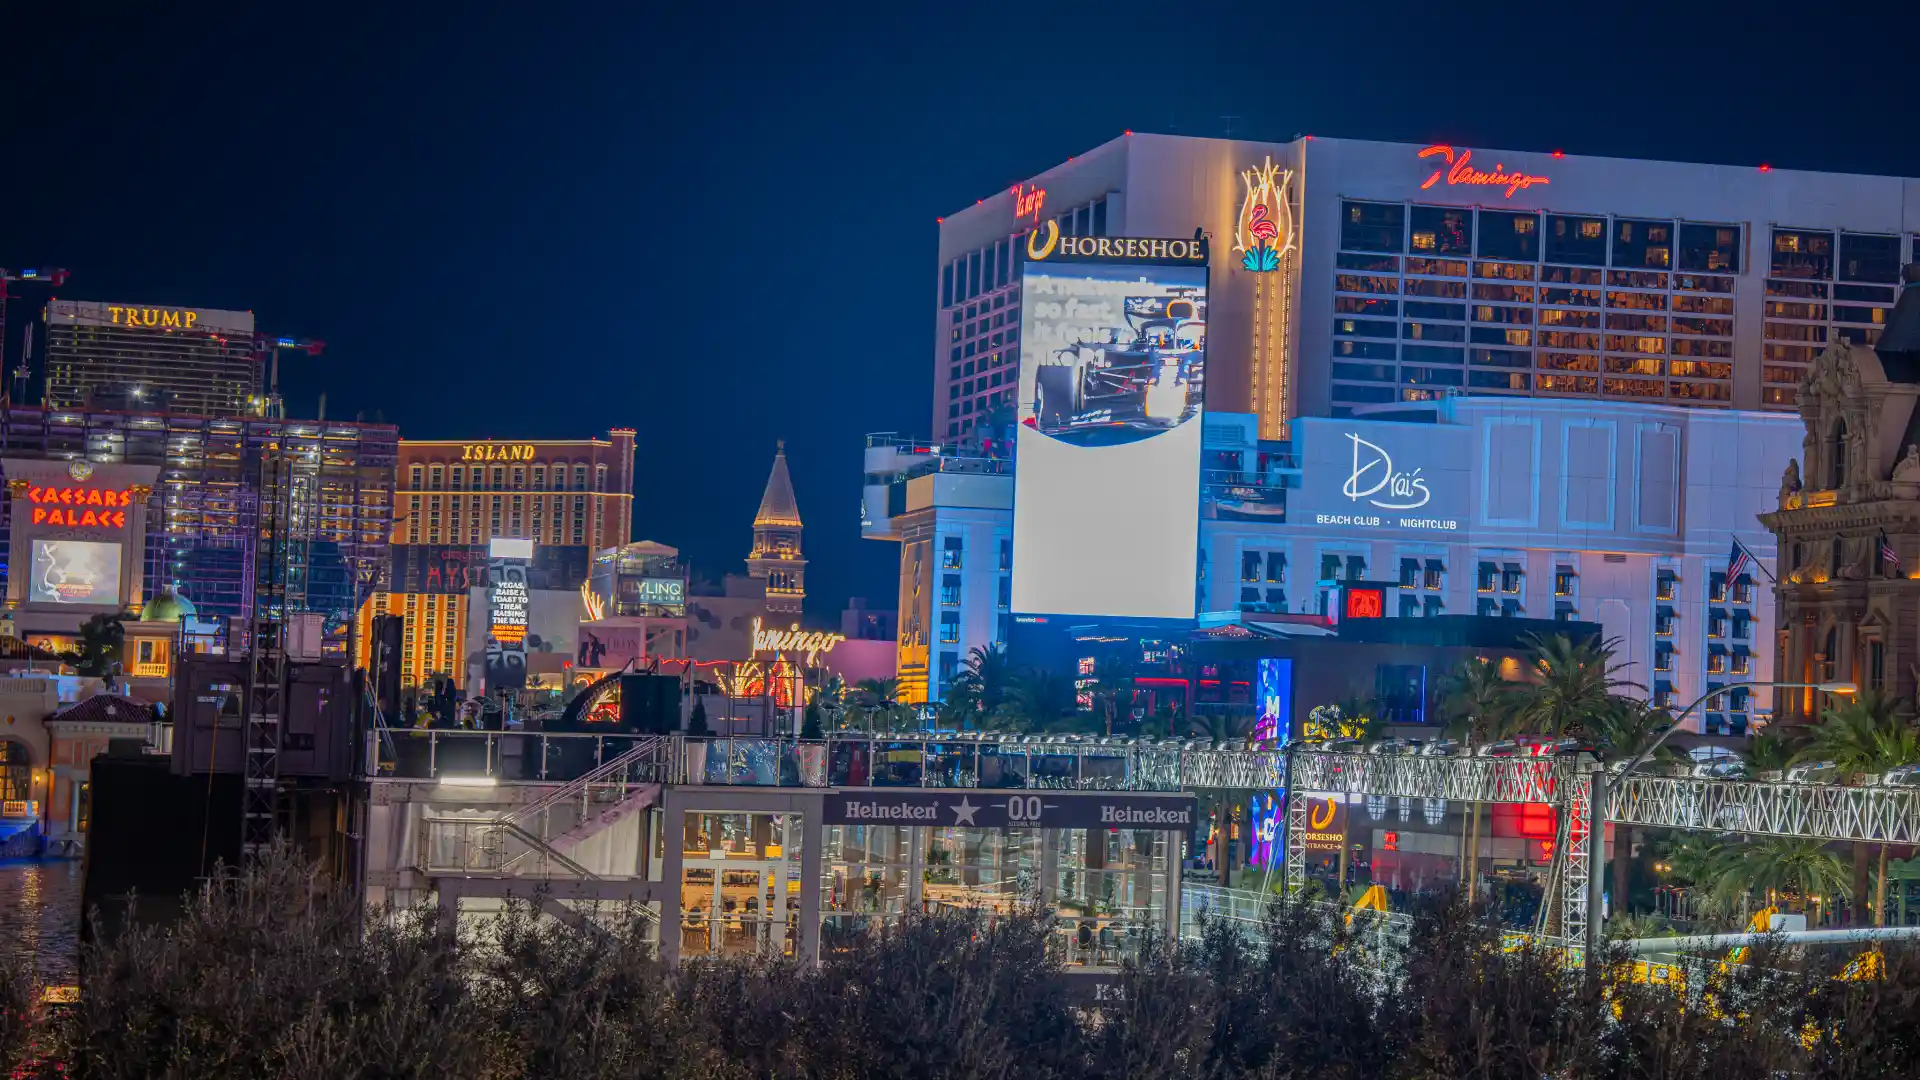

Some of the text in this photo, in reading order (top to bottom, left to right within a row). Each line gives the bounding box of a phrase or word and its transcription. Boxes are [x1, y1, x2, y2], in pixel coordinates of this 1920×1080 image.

[1417, 144, 1550, 198] Flamingo
[108, 306, 197, 329] TRUMP
[461, 445, 535, 460] ISLAND
[1343, 432, 1430, 509] Drai's
[28, 487, 132, 508] CAESARS
[32, 507, 125, 529] PALACE
[1316, 514, 1457, 530] BEACH CLUB NIGHTCLUB
[492, 595, 517, 603] TOAST
[496, 588, 519, 596] RAISE
[1008, 796, 1042, 821] 0.0
[1299, 833, 1343, 842] ORSESHO
